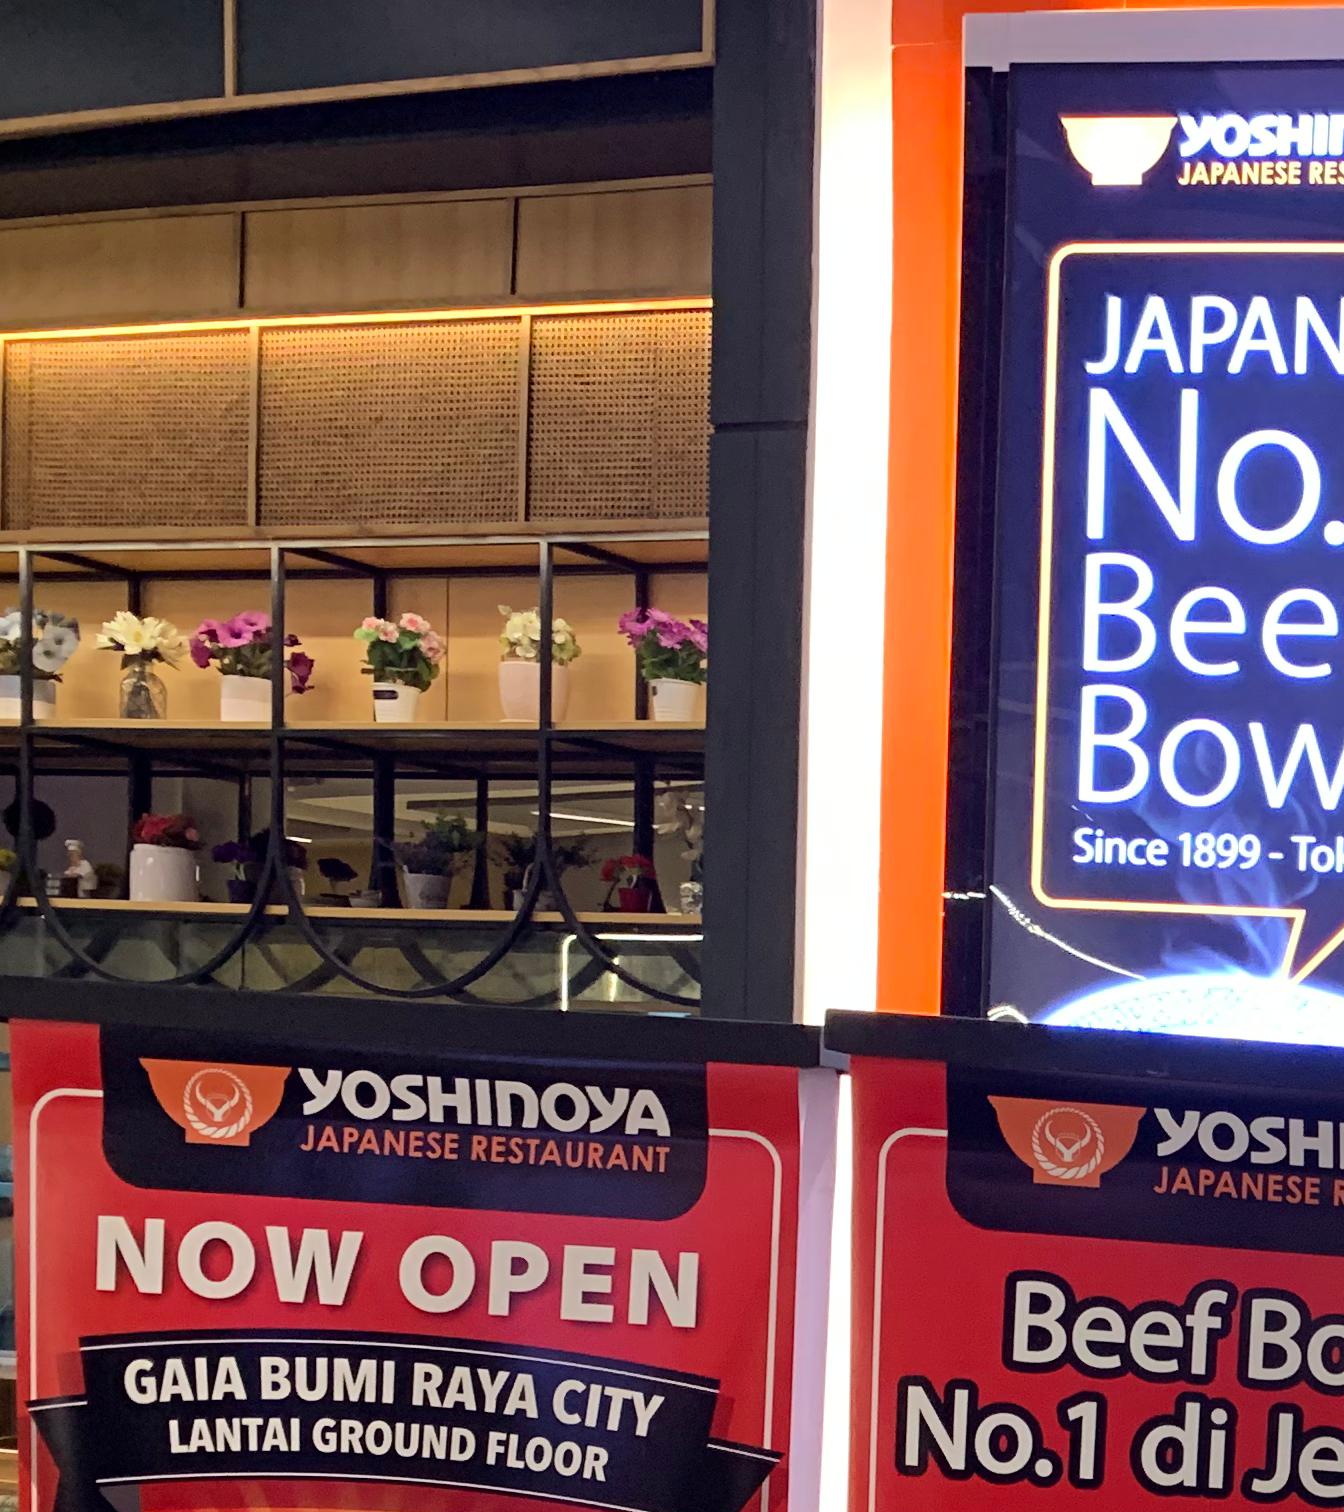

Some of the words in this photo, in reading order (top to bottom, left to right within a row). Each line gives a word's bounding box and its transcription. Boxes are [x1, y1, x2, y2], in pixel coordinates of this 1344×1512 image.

[1178, 161, 1302, 186] JAPANESE
[1072, 826, 1169, 868] Since
[1179, 832, 1260, 870] 1899
[298, 1067, 671, 1137] YOSHINOYA
[299, 1124, 460, 1161] JAPANESE
[470, 1135, 670, 1174] RESTAURANT
[1153, 1166, 1322, 1206] JAPANESE
[95, 1215, 365, 1307] NOW
[399, 1235, 700, 1329] OPEN
[1011, 1279, 1228, 1377] Beef
[123, 1356, 248, 1405] GAIA
[260, 1358, 395, 1406] BUMI
[411, 1363, 540, 1420] RAYA
[553, 1379, 666, 1438] CITY
[168, 1417, 302, 1454] LANTAI
[312, 1420, 476, 1463] GROUND
[486, 1436, 610, 1482] FLOOR
[903, 1386, 1098, 1482] No.1
[1140, 1403, 1229, 1491] di
